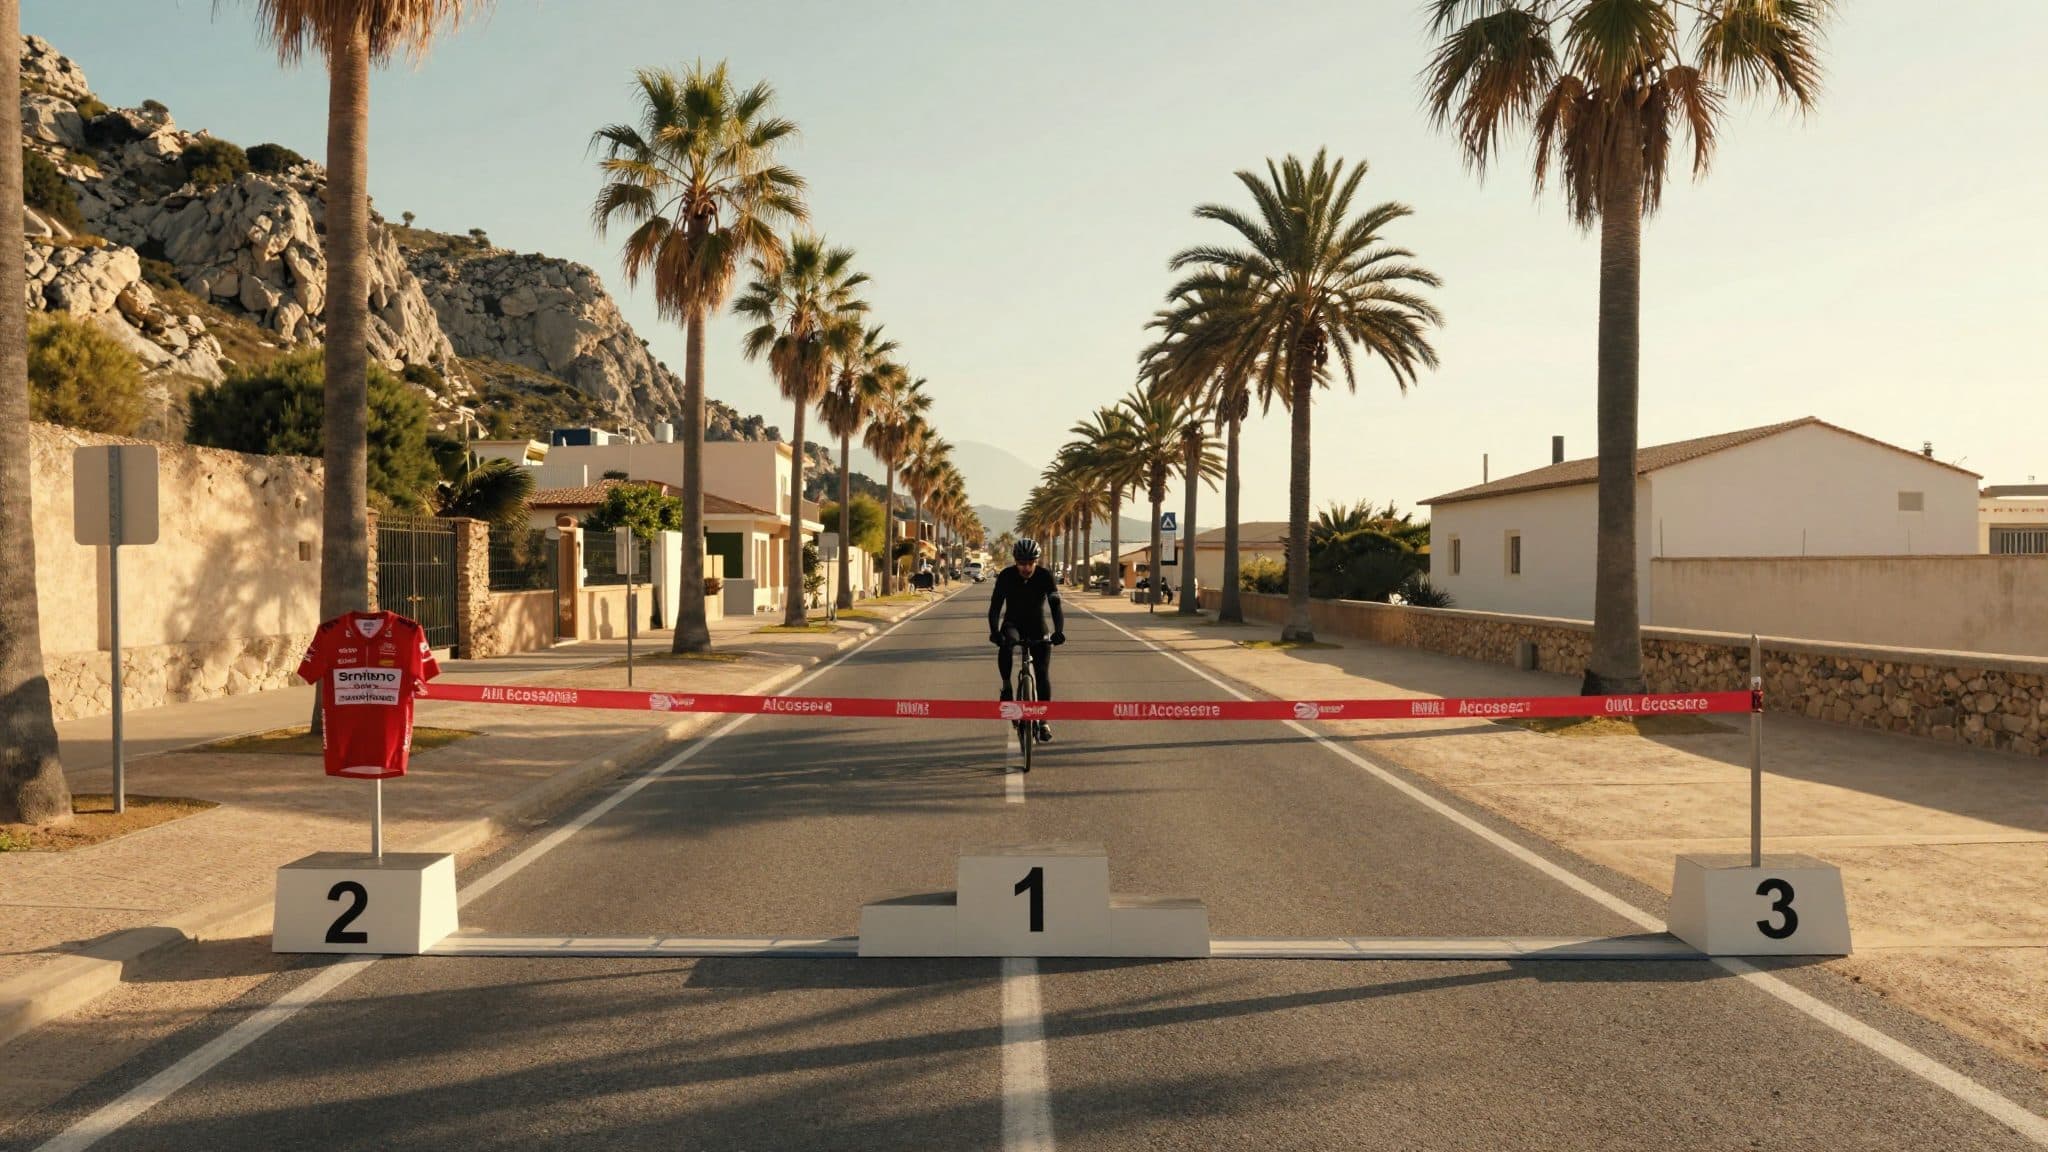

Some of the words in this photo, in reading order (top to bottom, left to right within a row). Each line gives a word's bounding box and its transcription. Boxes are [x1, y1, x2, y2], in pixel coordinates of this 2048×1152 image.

[325, 881, 368, 943] 2
[1014, 867, 1044, 932] 1
[1756, 878, 1798, 939] 3
